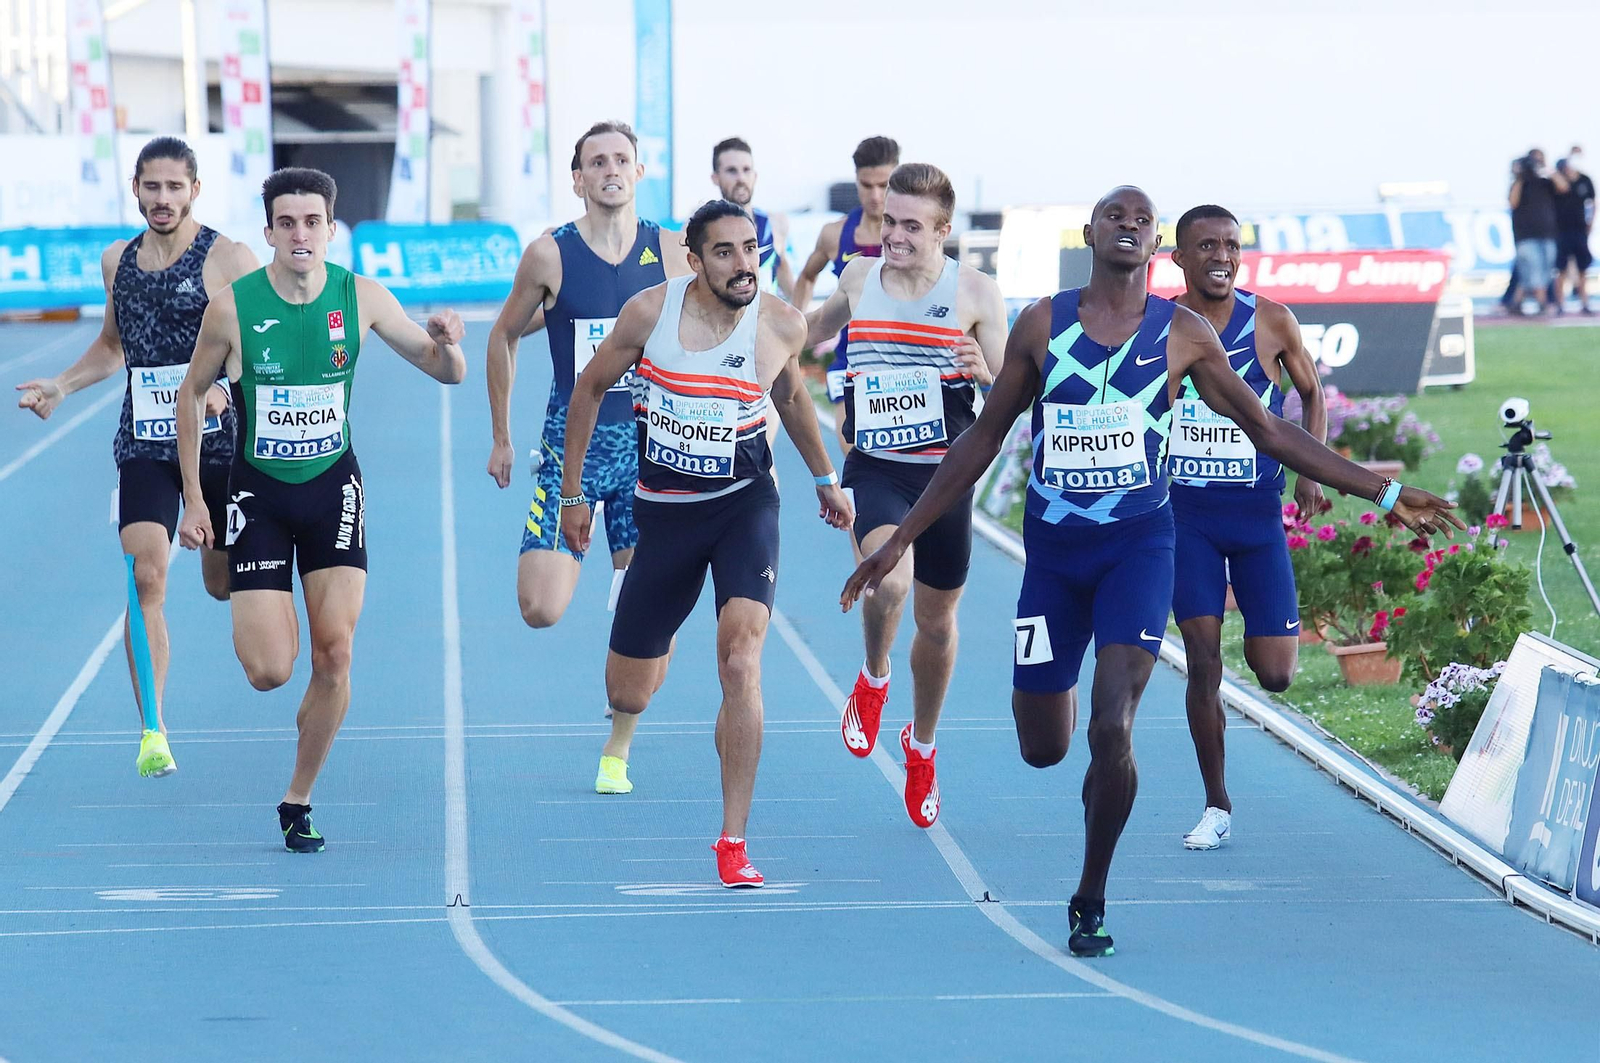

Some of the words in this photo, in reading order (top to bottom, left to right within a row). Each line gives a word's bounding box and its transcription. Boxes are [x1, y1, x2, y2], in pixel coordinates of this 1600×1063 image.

[1256, 256, 1342, 293] Long
[1347, 255, 1445, 292] Jump
[895, 378, 928, 388] HUELVA
[869, 393, 926, 414] MIRON
[268, 407, 337, 426] GARCIA
[690, 409, 724, 417] HUELVA
[1092, 413, 1129, 424] HUELVA
[892, 415, 904, 425] 11
[650, 411, 734, 442] ORDOÑEZ
[300, 429, 307, 440] 7
[1180, 425, 1241, 443] TSHITE
[679, 441, 690, 453] 81
[1052, 431, 1135, 452] KIPRUTO
[1205, 447, 1212, 456] 4
[1090, 456, 1096, 467] 1
[1016, 624, 1036, 658] 7
